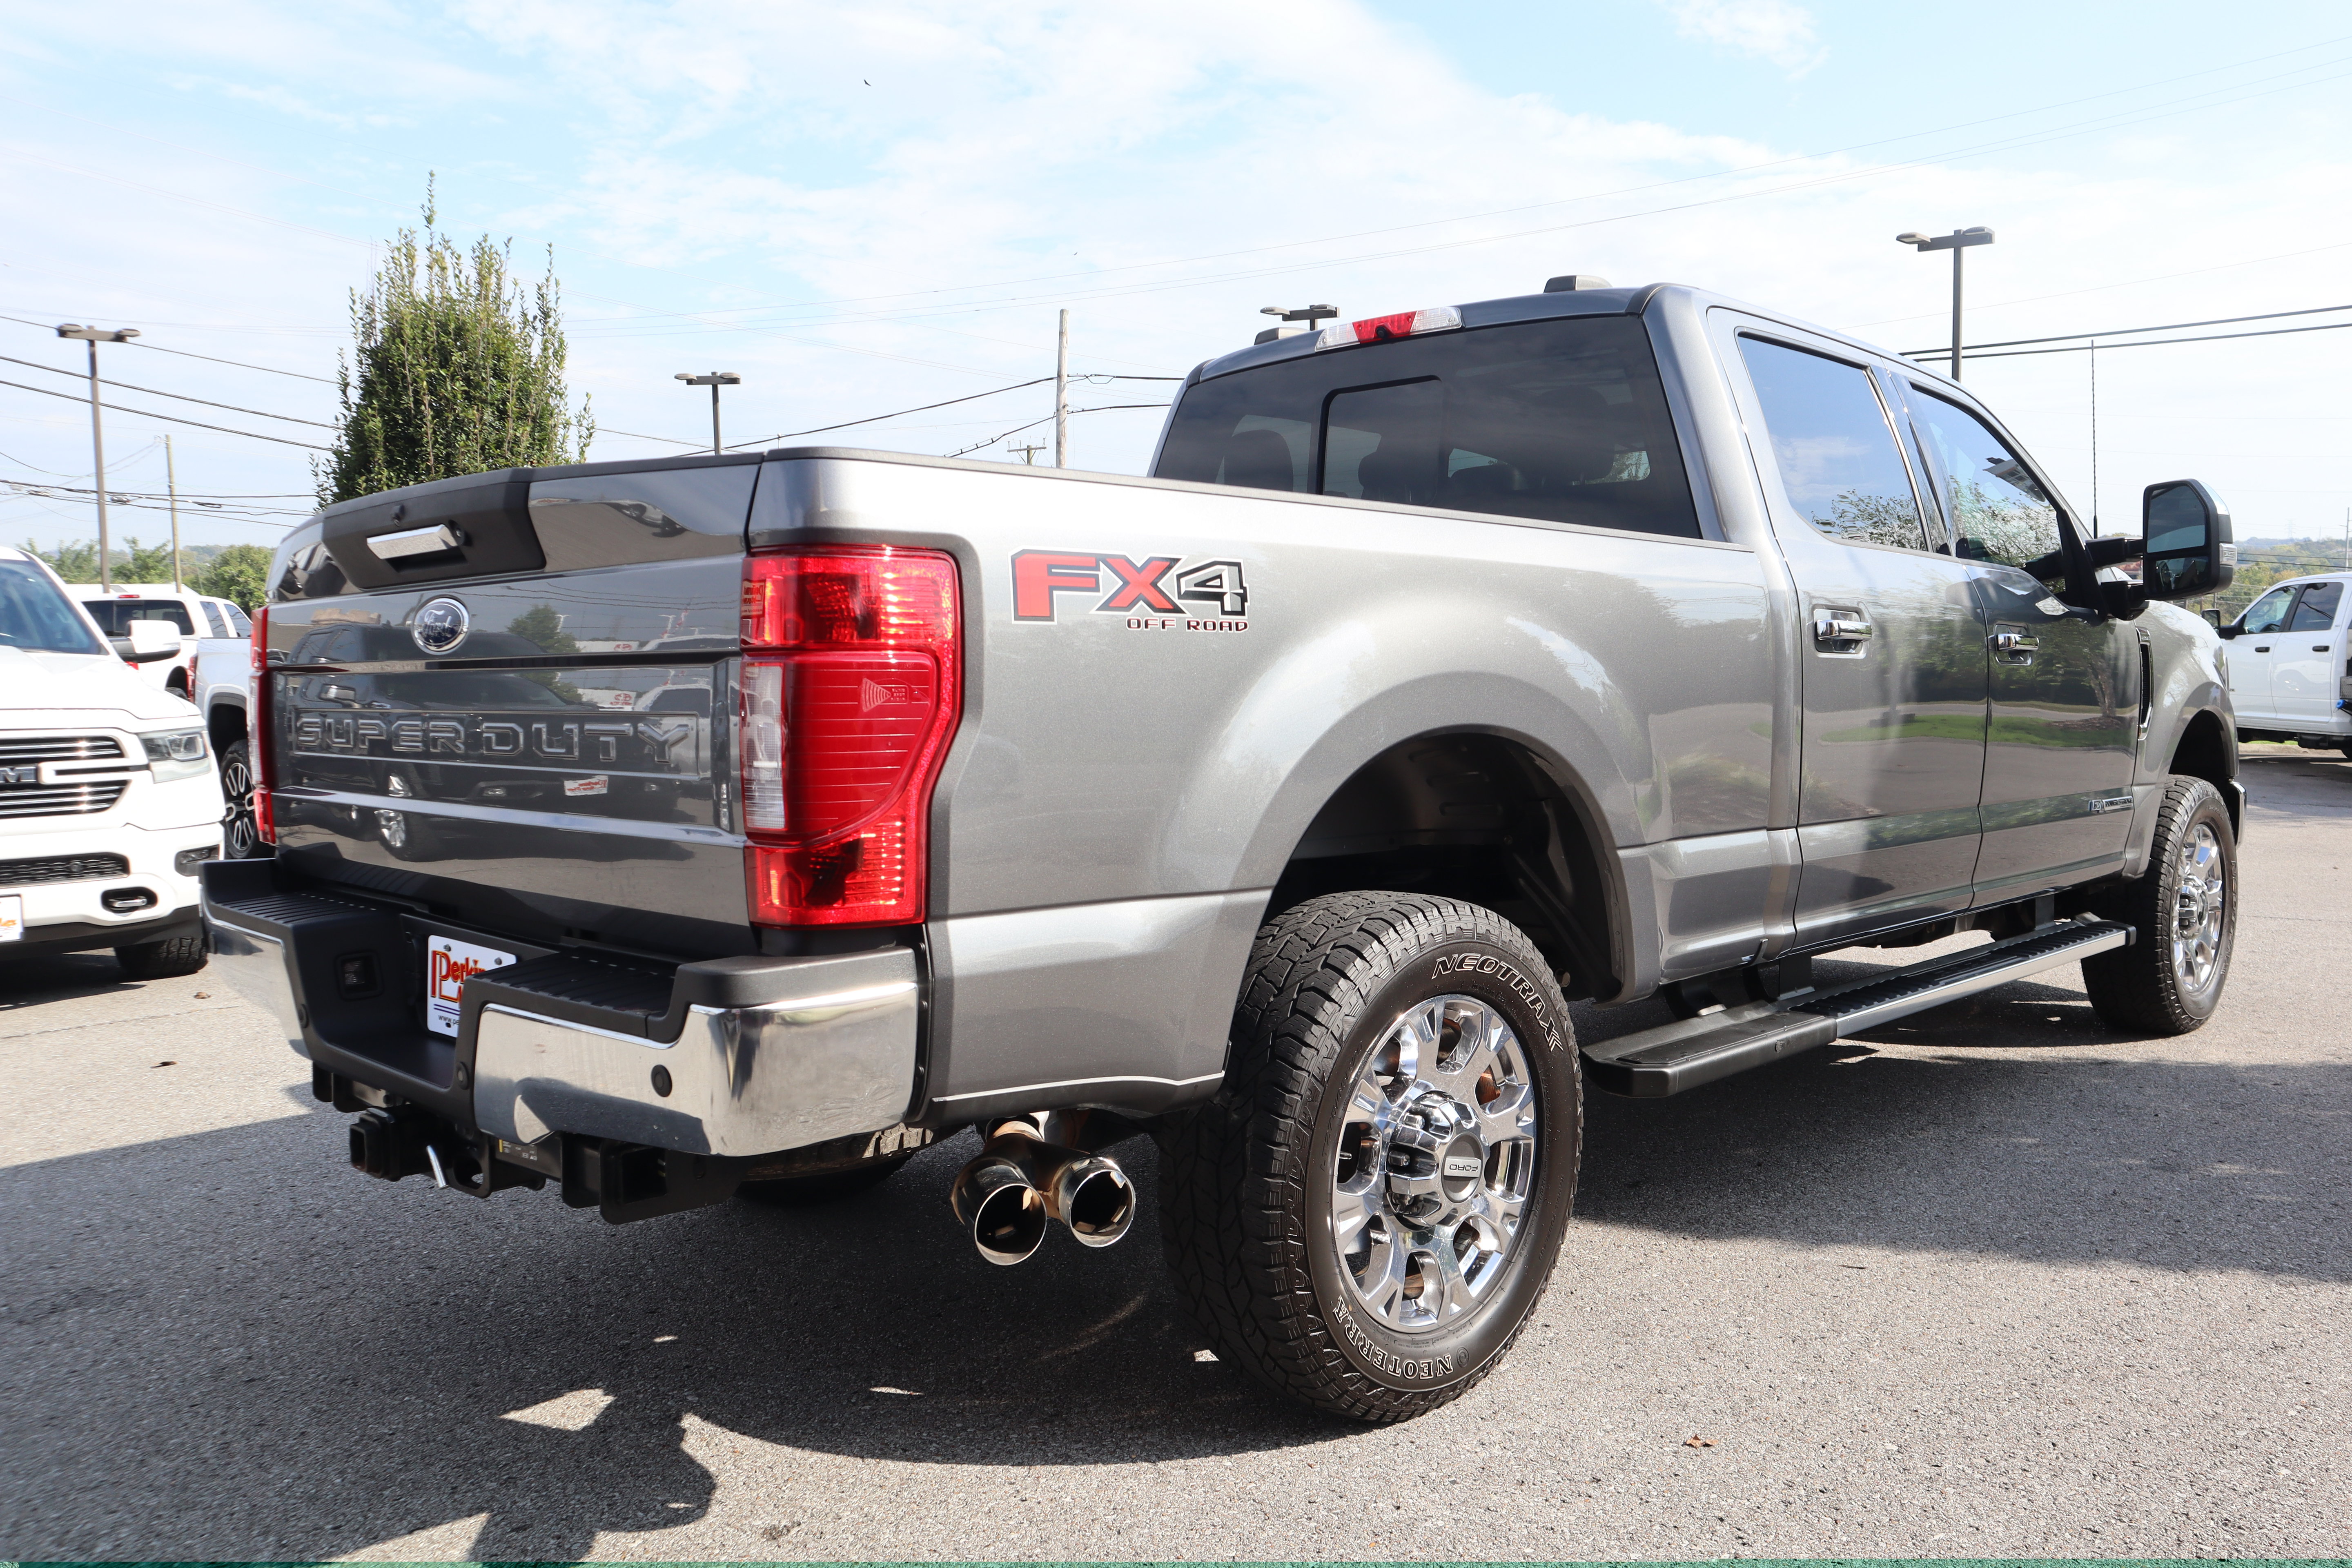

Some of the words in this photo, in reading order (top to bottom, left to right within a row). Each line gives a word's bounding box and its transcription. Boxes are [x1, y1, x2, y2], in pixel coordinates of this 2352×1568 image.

[1008, 545, 1250, 624] FX4
[423, 610, 452, 640] Ford
[1126, 616, 1177, 630] OFF
[1185, 618, 1250, 633] ROAD
[296, 718, 465, 754] SUPER
[483, 722, 690, 764] DUTY
[1449, 1164, 1478, 1172] FORD
[1332, 1294, 1454, 1380] NEOTERRA
